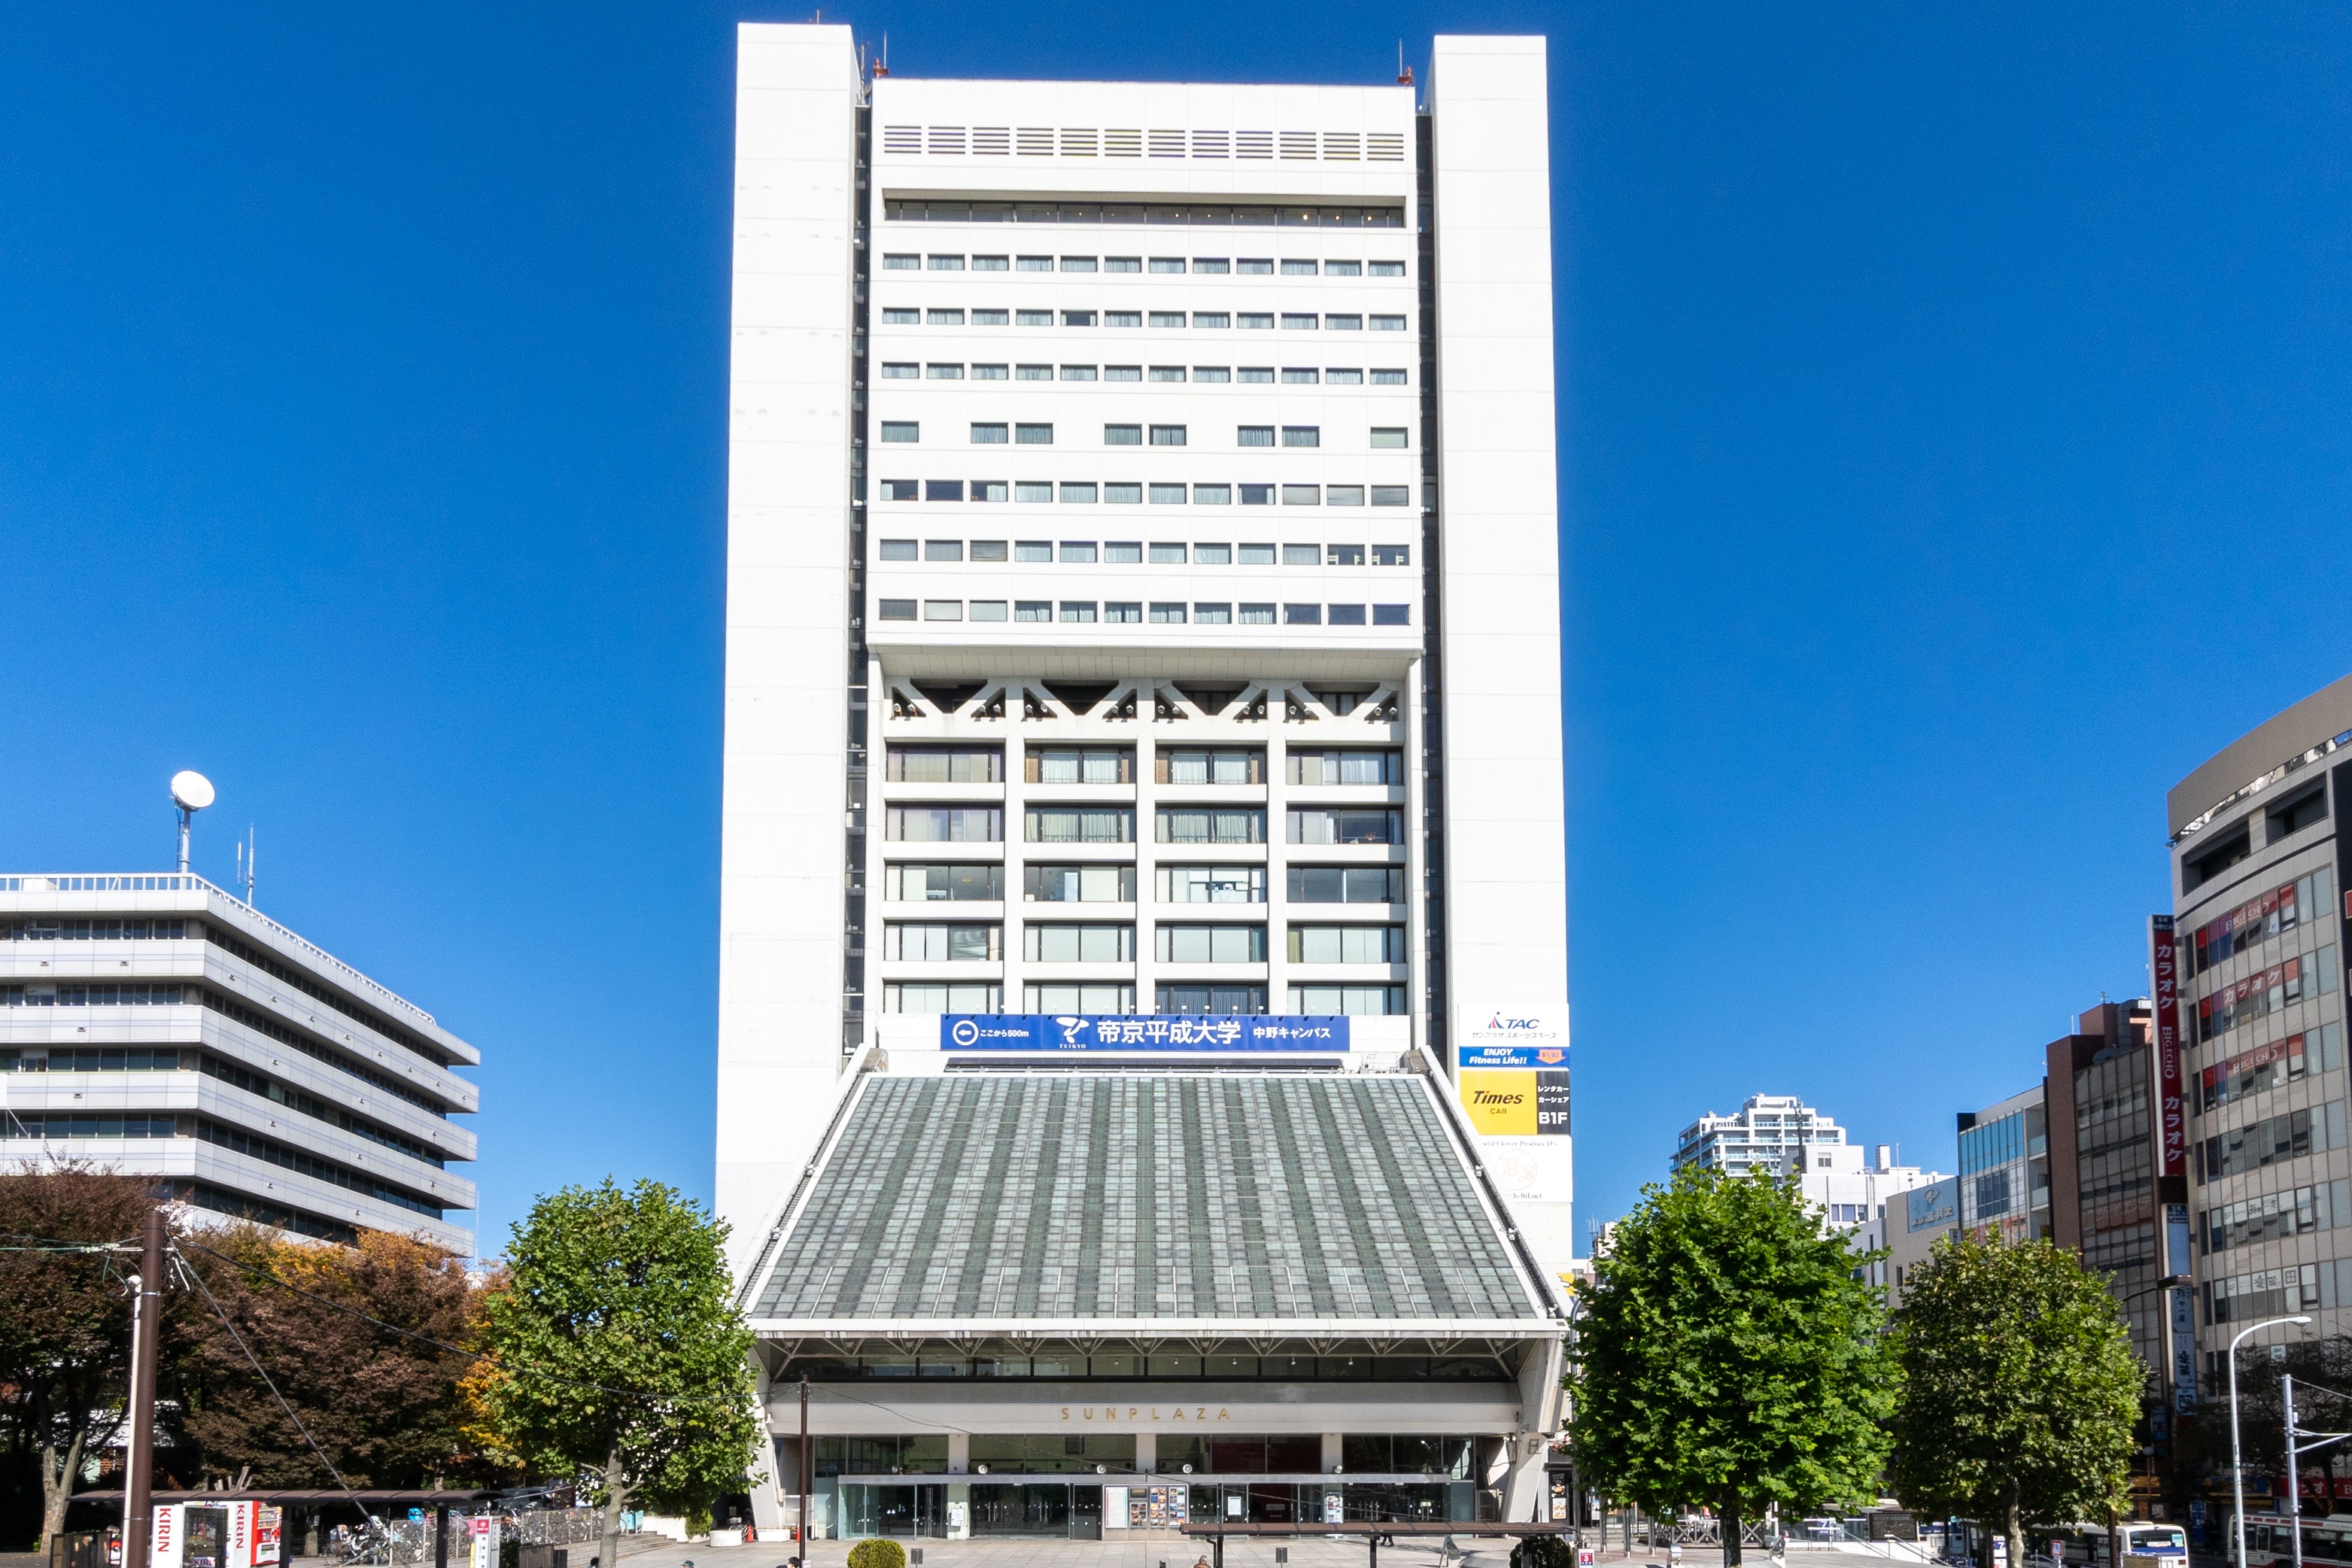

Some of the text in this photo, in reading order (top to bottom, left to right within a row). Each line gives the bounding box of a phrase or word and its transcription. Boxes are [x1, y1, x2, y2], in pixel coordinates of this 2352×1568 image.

[2157, 944, 2175, 1009] カラオケ
[2224, 970, 2281, 1004] カラオケ
[1506, 1019, 1540, 1029] TAC
[980, 1029, 1029, 1038] ここから500m
[1096, 1020, 1241, 1044] 帝京平成大学
[1253, 1026, 1332, 1039] 中野キャンパス
[1484, 1048, 1513, 1056] ENJOY
[1469, 1056, 1527, 1065] Fitness Life!!
[1472, 1090, 1524, 1105] Times
[1538, 1111, 1568, 1125] B1F
[2165, 1096, 2183, 1162] カラオケ
[1061, 1408, 1230, 1421] SUNPLAZA
[157, 1508, 172, 1552] KIRIN
[236, 1505, 245, 1548] KIRIN
[1998, 1541, 2005, 1550] 7
